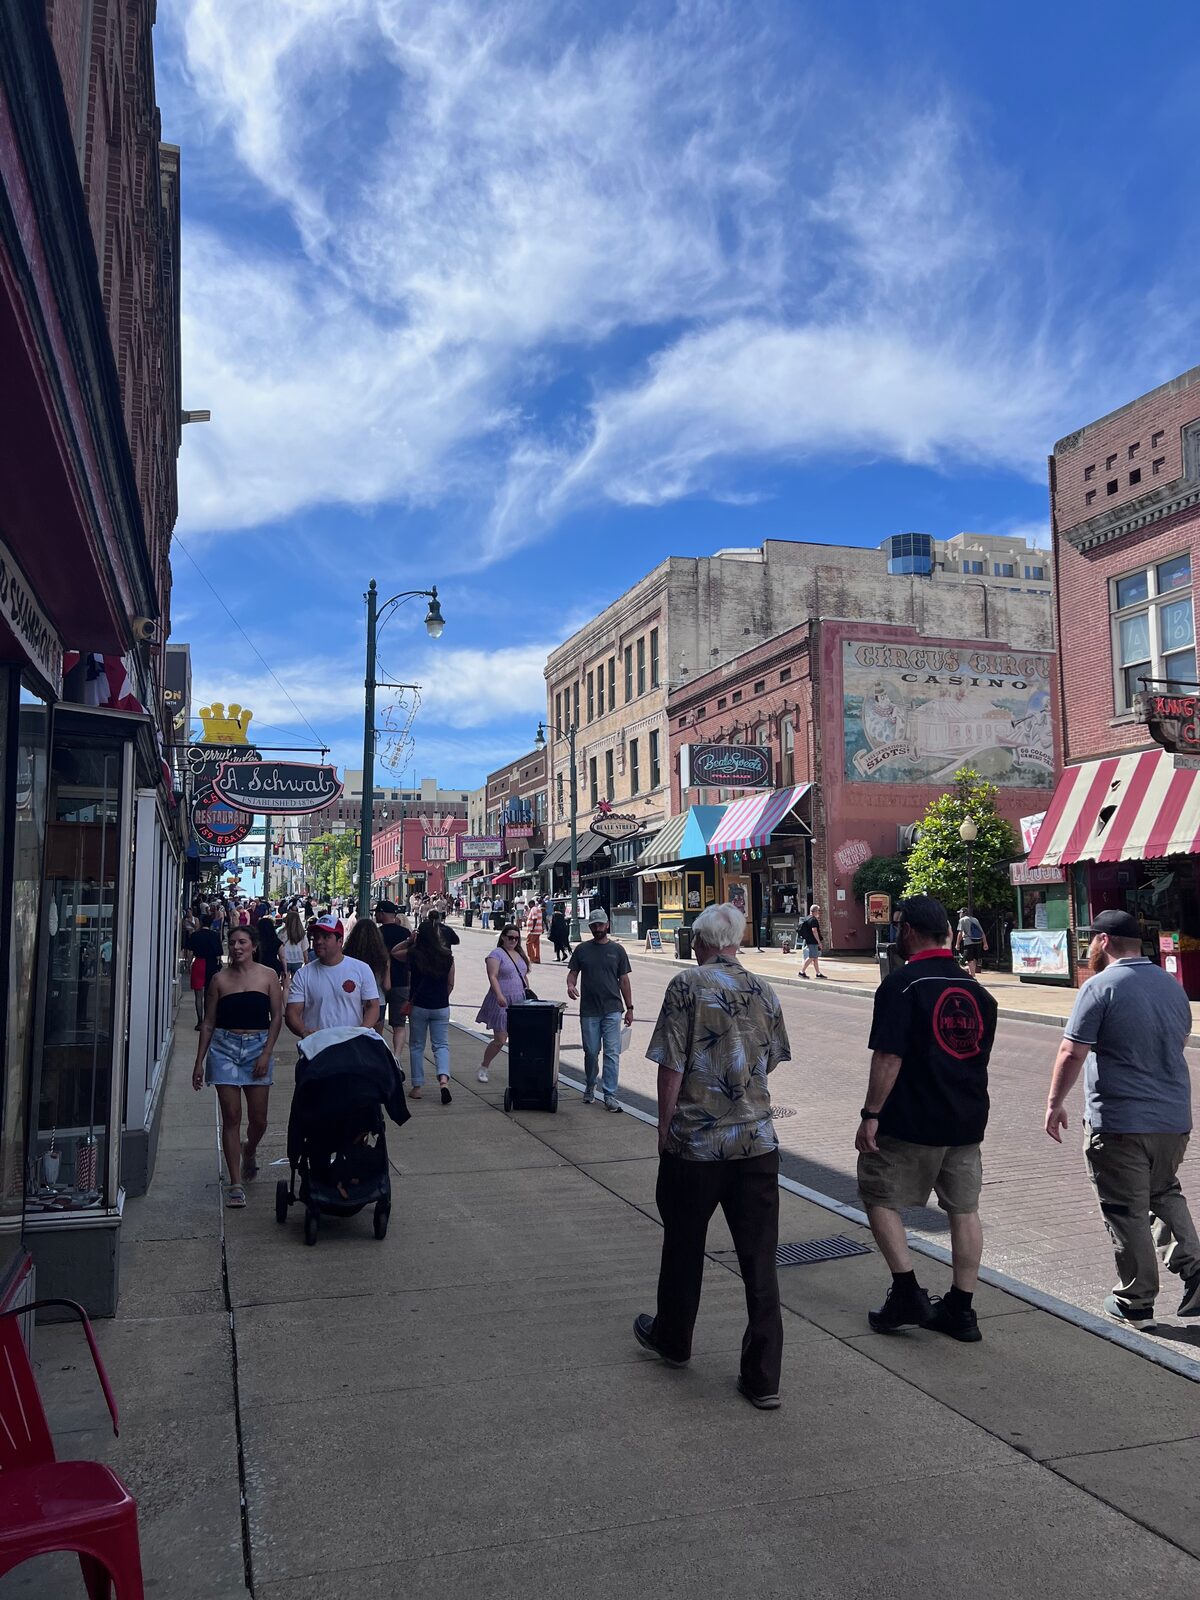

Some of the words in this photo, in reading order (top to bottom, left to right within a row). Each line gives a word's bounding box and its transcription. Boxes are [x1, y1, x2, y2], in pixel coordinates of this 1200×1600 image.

[855, 645, 960, 673] CIRCUS
[901, 673, 1028, 690] CASINO
[187, 747, 226, 775] Jerry
[219, 767, 244, 790] A.
[248, 767, 335, 794] Schwab
[242, 797, 297, 807] ESTABLISHED
[298, 799, 315, 807] 1876
[195, 809, 250, 826] RESTAURANT
[503, 809, 532, 823] BLUES
[199, 826, 214, 839] 159
[216, 826, 247, 844] BEALE
[209, 845, 226, 853] BLUES
